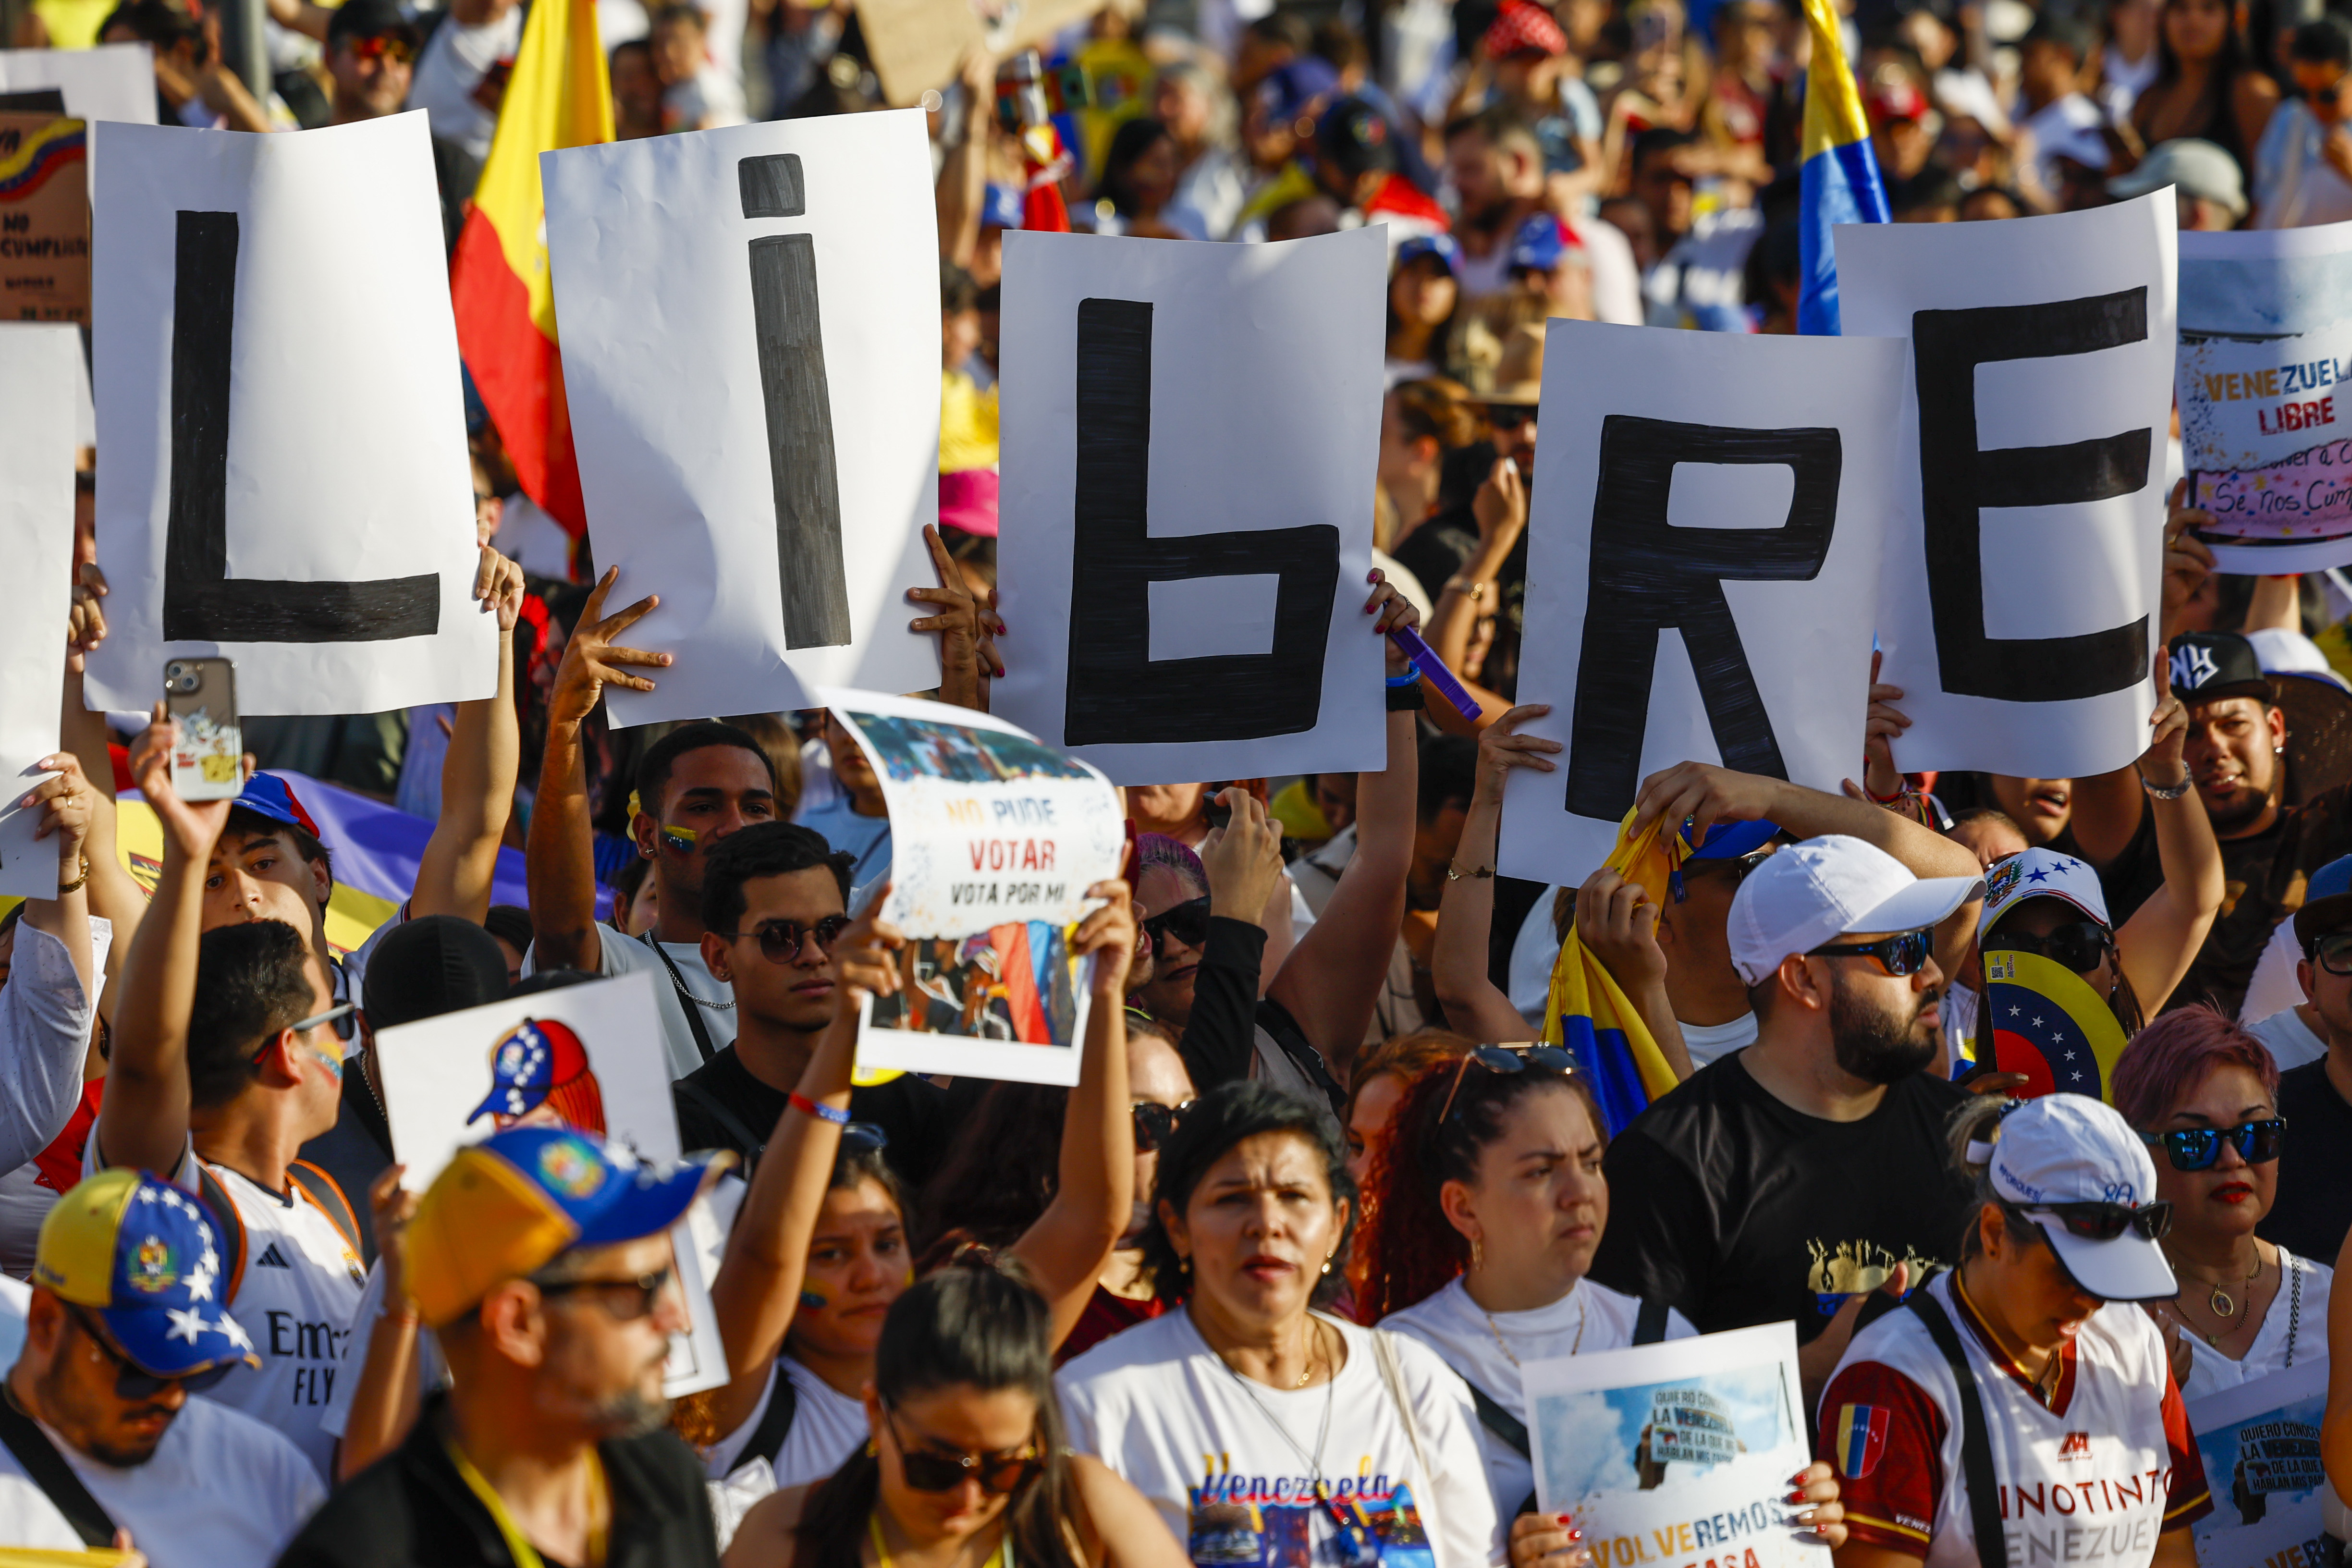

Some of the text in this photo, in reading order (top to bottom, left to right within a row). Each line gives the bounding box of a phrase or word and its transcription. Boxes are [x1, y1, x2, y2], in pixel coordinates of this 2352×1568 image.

[2204, 358, 2352, 402] VENEZUEL
[2258, 397, 2335, 436] LIBRE
[2216, 480, 2352, 513] Se nos Cum
[944, 797, 1058, 826] NO PUDE
[969, 838, 1055, 871] VOTAR
[951, 883, 998, 904] VOTA
[1006, 883, 1041, 904] POR
[293, 1368, 335, 1405] FLY
[1655, 1391, 1696, 1405] QUIERO
[1653, 1408, 1670, 1424] LA
[2241, 1422, 2281, 1442] QUIERO
[2241, 1443, 2261, 1461] LA
[2271, 1459, 2285, 1474] DE
[2287, 1459, 2300, 1473] LA
[2301, 1459, 2320, 1473] QUE
[1999, 1468, 2173, 1519] INOTINT
[2253, 1475, 2290, 1490] HABLAN
[1589, 1498, 1783, 1568] VOLVEREMOS
